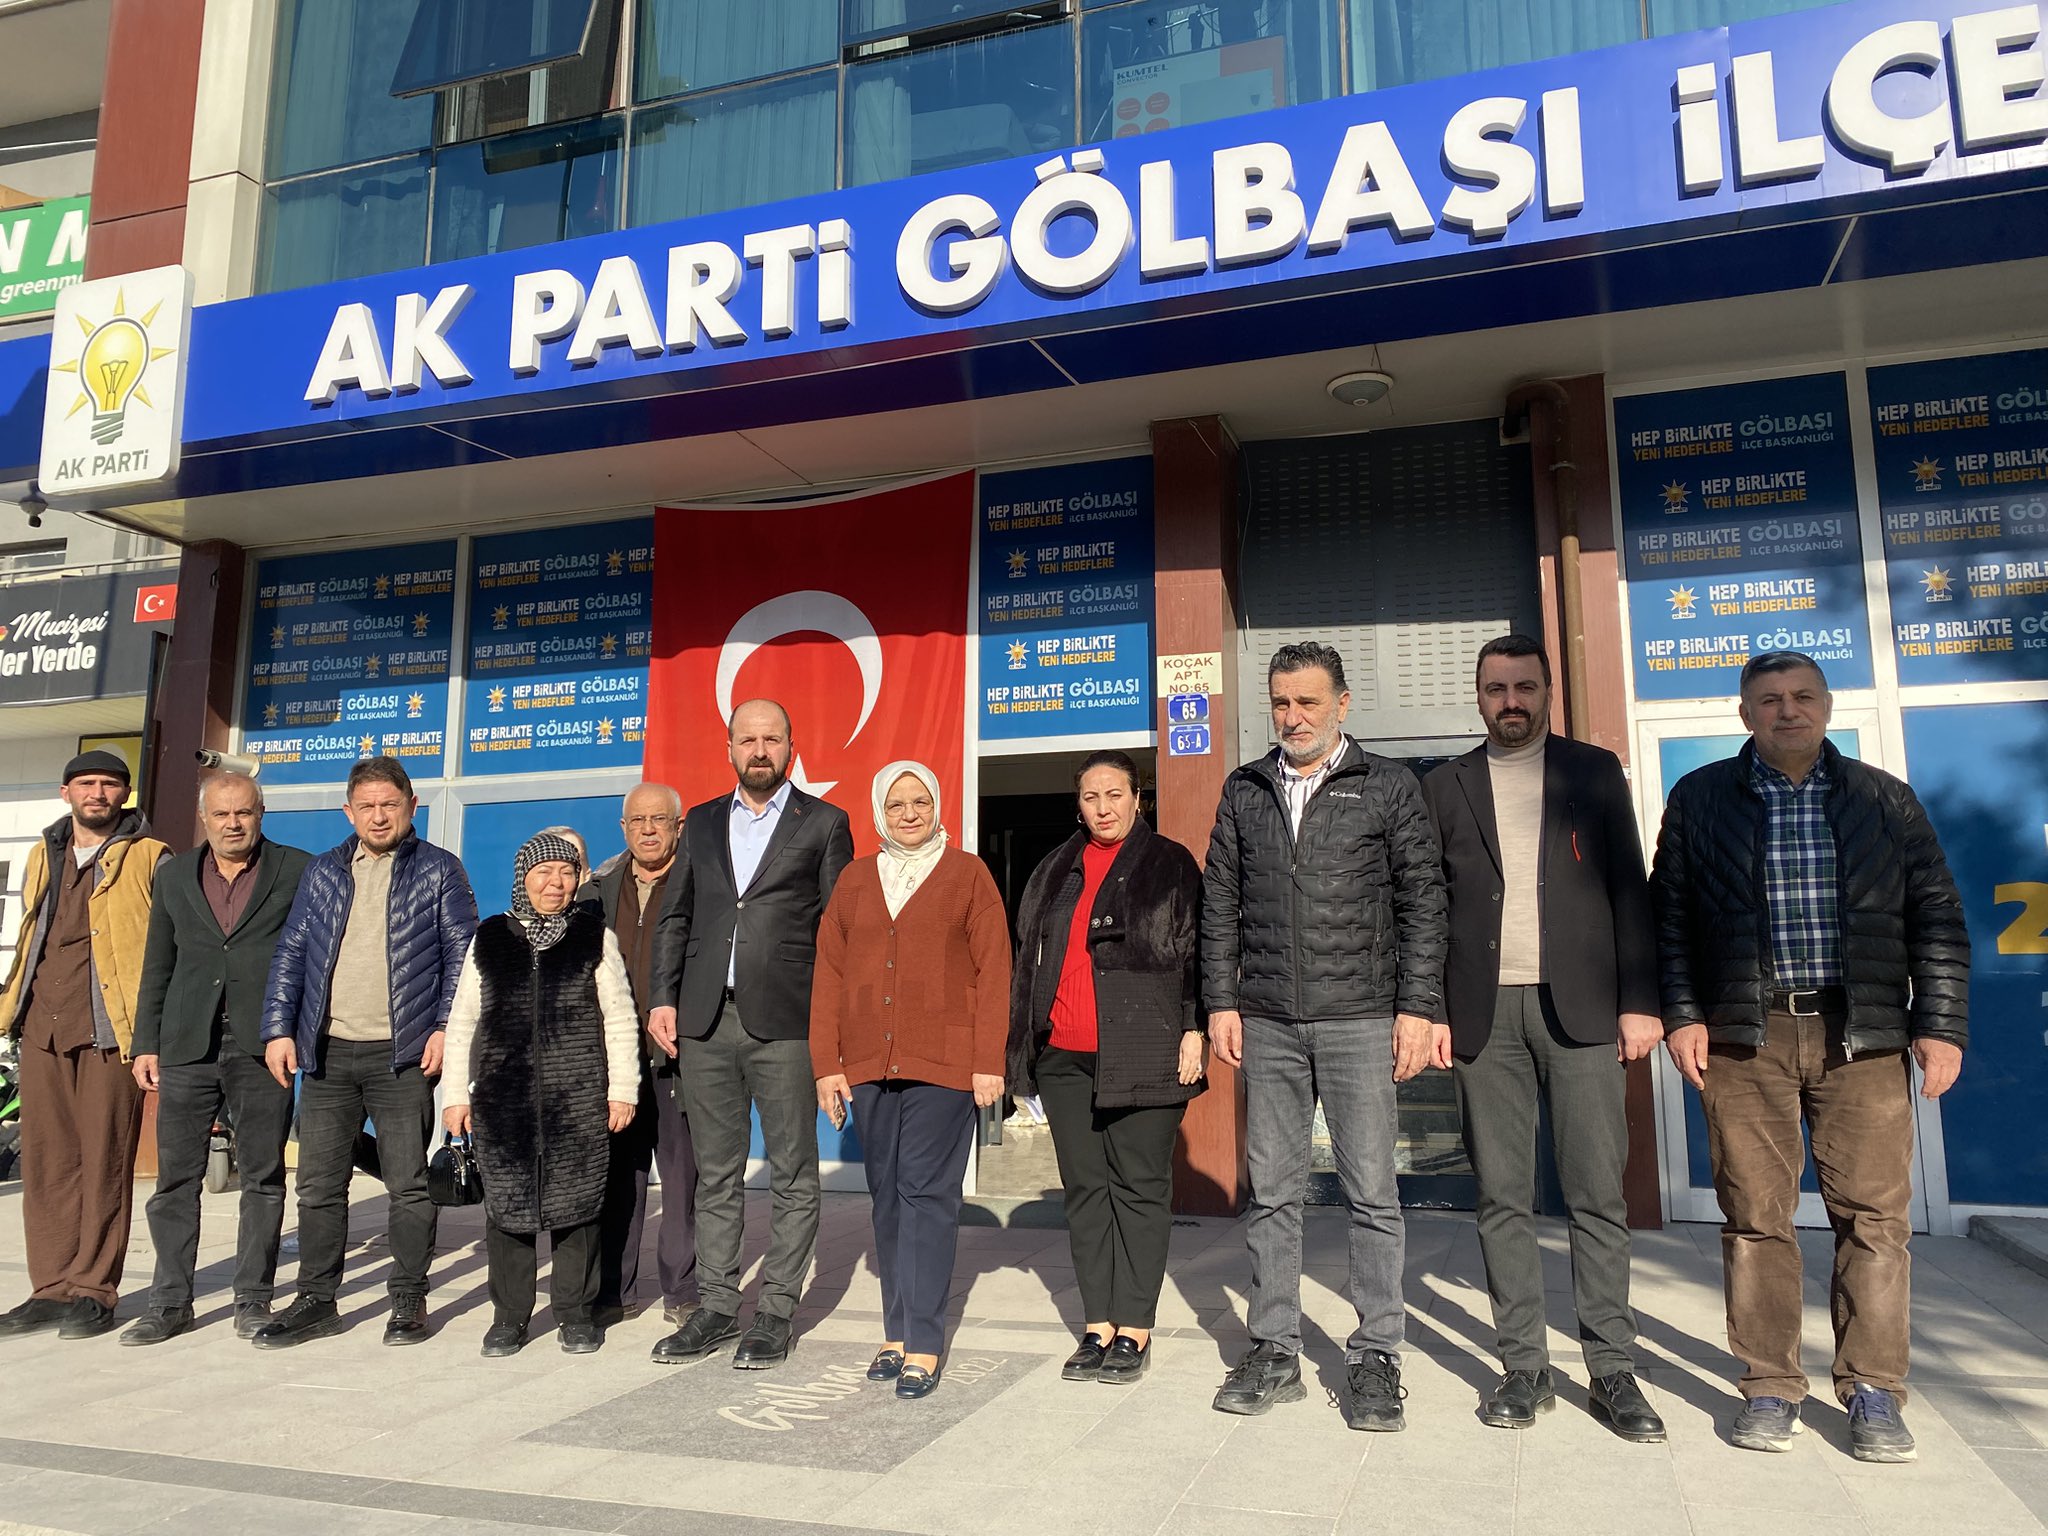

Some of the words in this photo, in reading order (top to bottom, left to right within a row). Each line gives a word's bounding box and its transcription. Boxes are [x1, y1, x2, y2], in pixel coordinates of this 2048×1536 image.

[1117, 64, 1168, 80] KUMTEL
[1117, 73, 1158, 85] CONVECTOR
[304, 284, 474, 405] AK
[895, 87, 1585, 314] GÖLBAŞI
[1877, 404, 1908, 421] HEP
[1739, 412, 1832, 437] GÖLBAŞI
[1914, 414, 1989, 433] HEDEFLERE
[1632, 431, 1660, 447] HEP
[1664, 441, 1733, 458] HEDEFLERE
[55, 457, 84, 481] AK
[1956, 455, 1989, 471] HEP
[1702, 478, 1730, 495] HEP
[1069, 491, 1137, 511] GÖLBAŞI
[1735, 489, 1807, 507] HEDEFLERE
[988, 505, 1009, 519] HEP
[1012, 514, 1063, 529] HEDEFLERE
[1888, 513, 1919, 529] HEP
[1748, 519, 1841, 542] GÖLBAŞI
[1924, 525, 2001, 543] HEDEFLERE
[1639, 534, 1667, 550] HEP
[1038, 548, 1060, 562] HEP
[479, 565, 496, 577] HEP
[1062, 557, 1114, 572] HEDEFLERE
[1967, 564, 2000, 582] HEP
[1069, 584, 1138, 603] GÖLBAŞI
[1709, 585, 1739, 600] HEP
[517, 603, 535, 615] HEP
[988, 595, 1009, 609] HEP
[1744, 597, 1816, 613] HEDEFLERE
[9, 610, 109, 644] Mucizesi
[1897, 623, 1930, 641] HEP
[1037, 639, 1060, 653] HEP
[1756, 628, 1852, 650] GÖLBAŞI
[1935, 638, 2013, 655] HEDEFLERE
[475, 646, 492, 658] HEP
[1645, 640, 1674, 656] HEP
[32, 642, 96, 673] Yerde
[388, 653, 405, 665] HEP
[1062, 651, 1115, 665] HEDEFLERE
[1164, 657, 1213, 669] KOÇAK
[1679, 654, 1750, 669] HEDEFLERE
[1174, 671, 1203, 680] APT.
[513, 686, 530, 698] HEP
[582, 677, 638, 693] GÖLBAŞI
[1069, 678, 1139, 696] GÖLBAŞI
[1169, 683, 1209, 693] NO:65
[532, 696, 575, 708] HEDEFLERE
[987, 687, 1009, 701] HEP
[286, 702, 302, 713] HEP
[1011, 699, 1064, 712] HEDEFLERE
[1182, 702, 1196, 720] 65
[536, 720, 592, 736] GÖLBAŞI
[622, 717, 641, 729] HEP
[305, 735, 355, 750] GÖLBAŞI
[382, 734, 399, 745] HEP
[470, 729, 488, 741] HEP
[1177, 733, 1202, 750] 65-A
[247, 742, 262, 753] HEP
[399, 745, 440, 756] HEDEFLERE
[489, 739, 531, 751] HEDEFLERE
